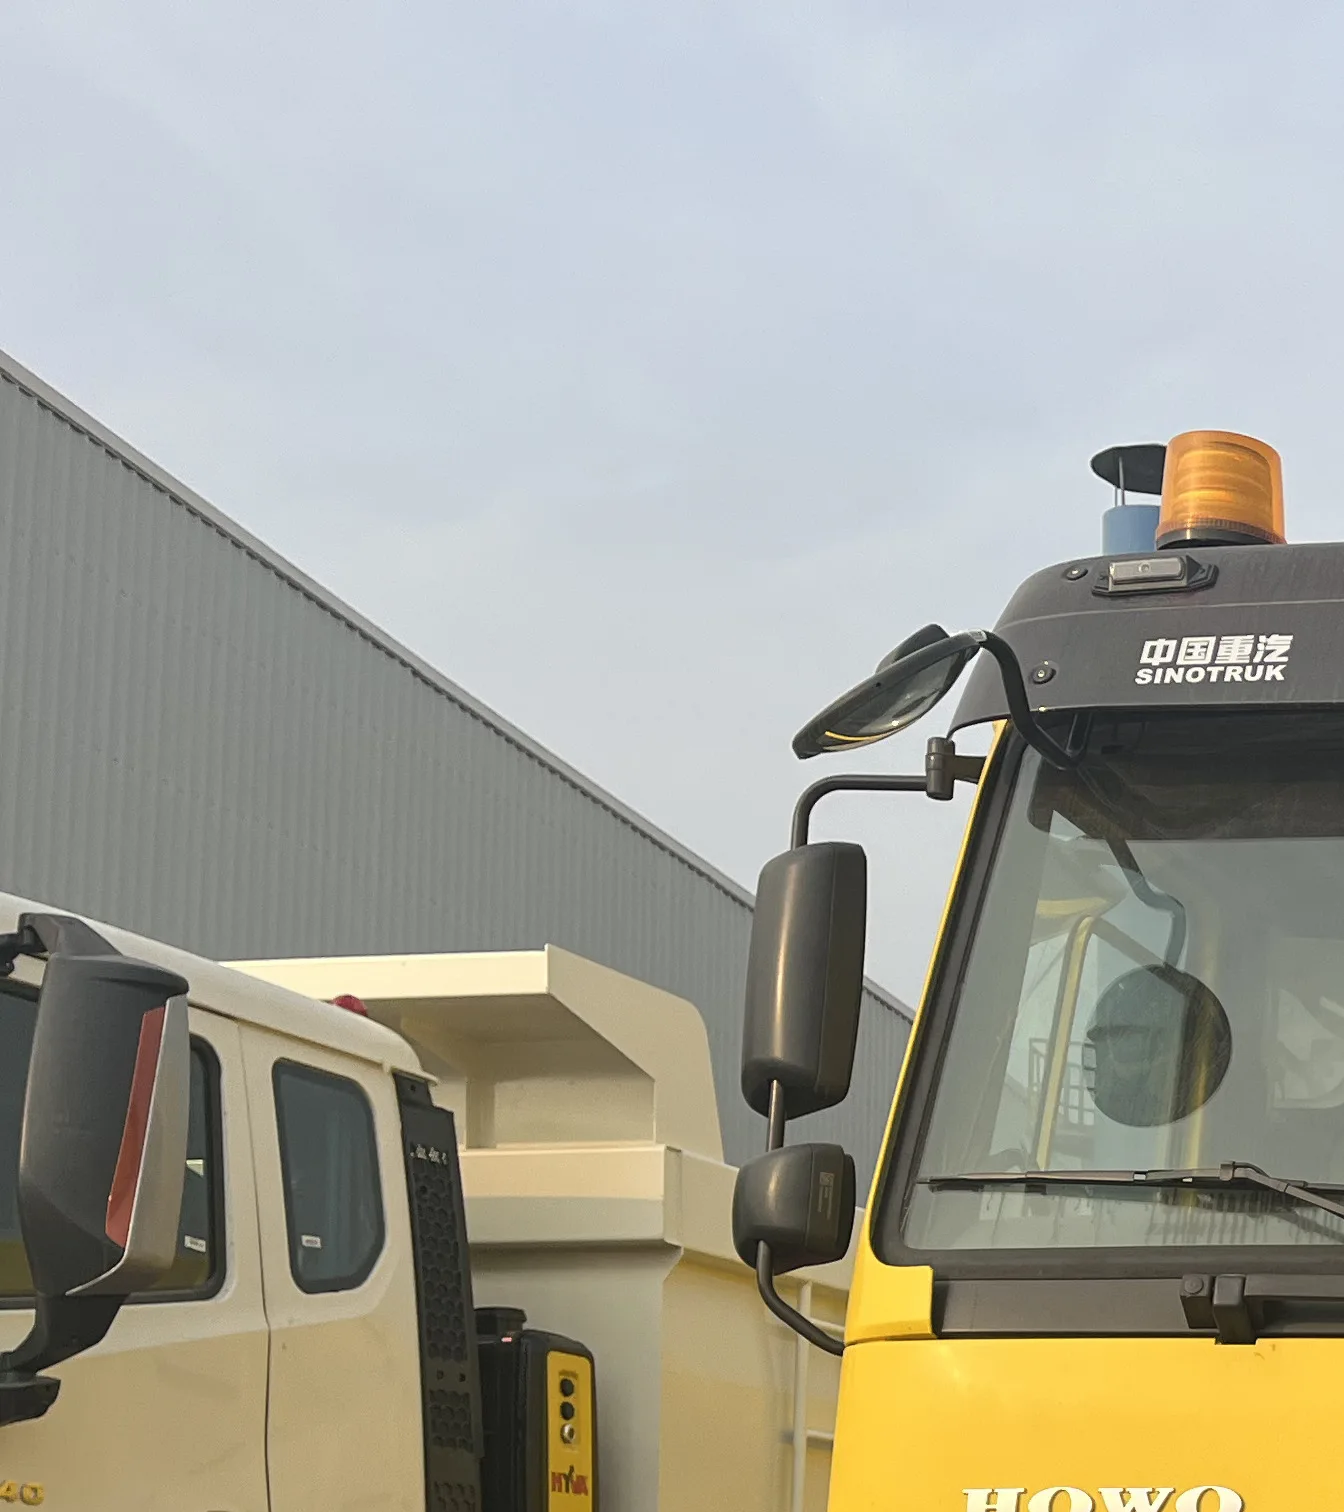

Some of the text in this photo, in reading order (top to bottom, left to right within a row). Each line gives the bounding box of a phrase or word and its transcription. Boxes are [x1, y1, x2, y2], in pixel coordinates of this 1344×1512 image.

[1139, 634, 1294, 666] 中国重汽
[1134, 664, 1287, 685] SINOTRUK
